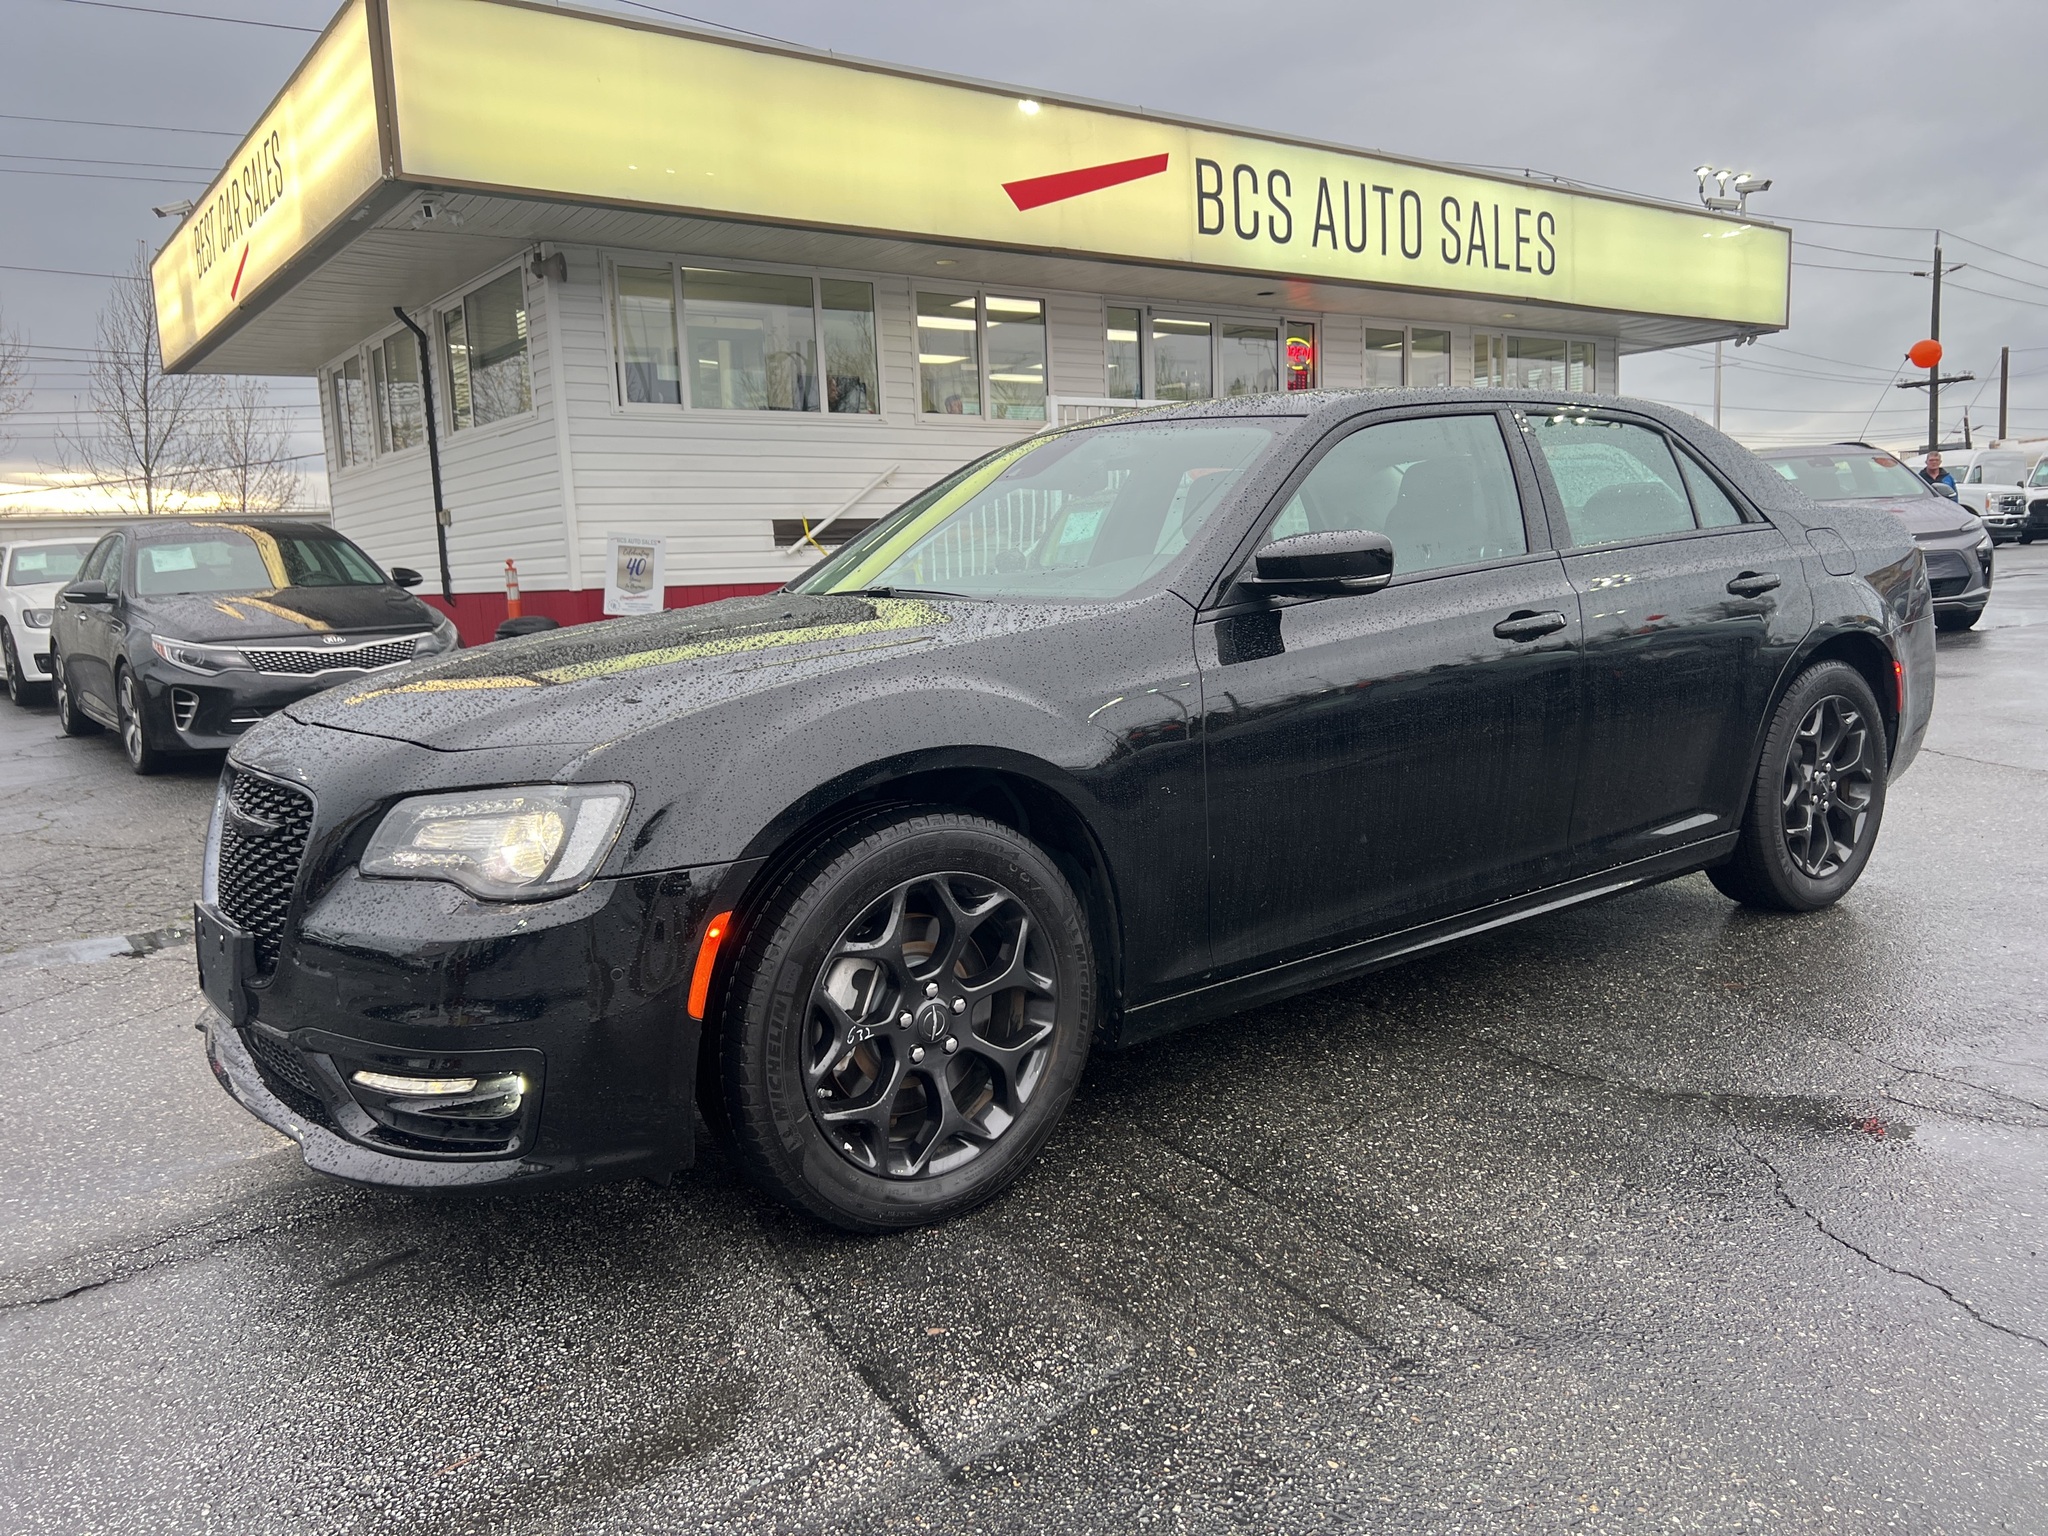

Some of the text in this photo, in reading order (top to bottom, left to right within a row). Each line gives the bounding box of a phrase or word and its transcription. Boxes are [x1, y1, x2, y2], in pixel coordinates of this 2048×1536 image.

[194, 130, 283, 279] BEST CAR SALES
[1195, 157, 1555, 276] BCS AUTO SALES
[626, 557, 647, 576] 40
[1074, 943, 1089, 1049] MICHELIN
[766, 999, 789, 1122] MICHELIN
